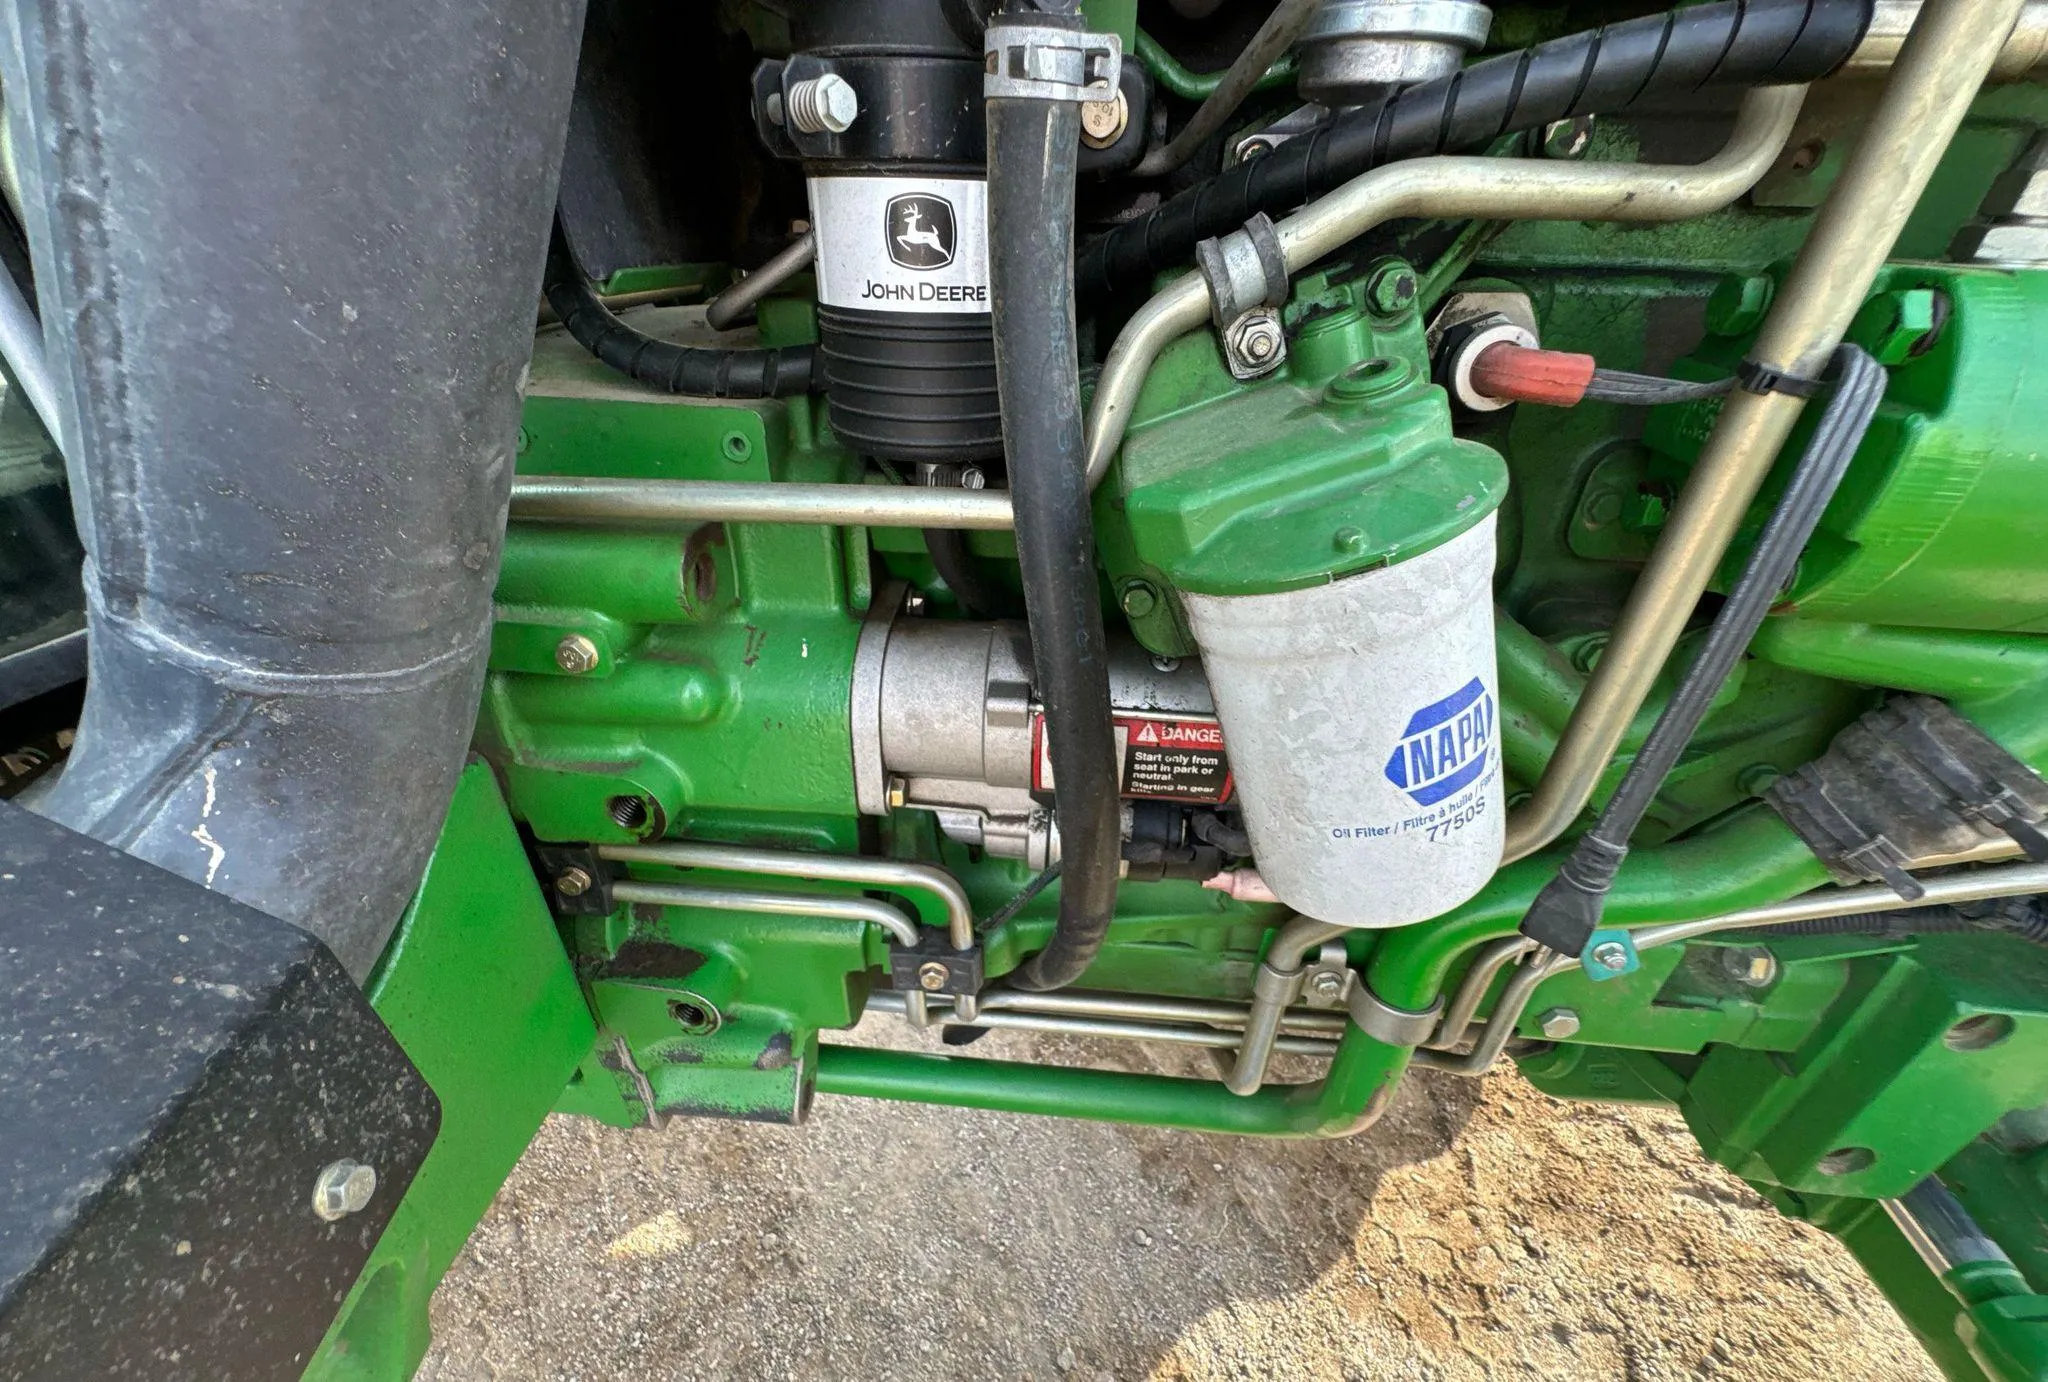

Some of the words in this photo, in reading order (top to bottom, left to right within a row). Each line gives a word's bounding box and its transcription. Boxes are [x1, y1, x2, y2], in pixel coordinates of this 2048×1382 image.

[861, 279, 914, 301] JOHN
[918, 282, 987, 302] DEERE
[1161, 726, 1223, 744] DANGE
[1409, 702, 1486, 786] NAPA
[1134, 751, 1162, 762] Start
[1164, 754, 1190, 766] only
[1192, 754, 1219, 766] from
[1133, 763, 1157, 772] seat
[1160, 763, 1172, 773] in
[1173, 766, 1199, 775] park
[1201, 767, 1214, 776] or
[1131, 781, 1175, 792] Starting
[1176, 784, 1188, 792] in
[1332, 828, 1351, 839] Oil
[1355, 826, 1391, 838] Filter
[1403, 813, 1436, 831] Filtre
